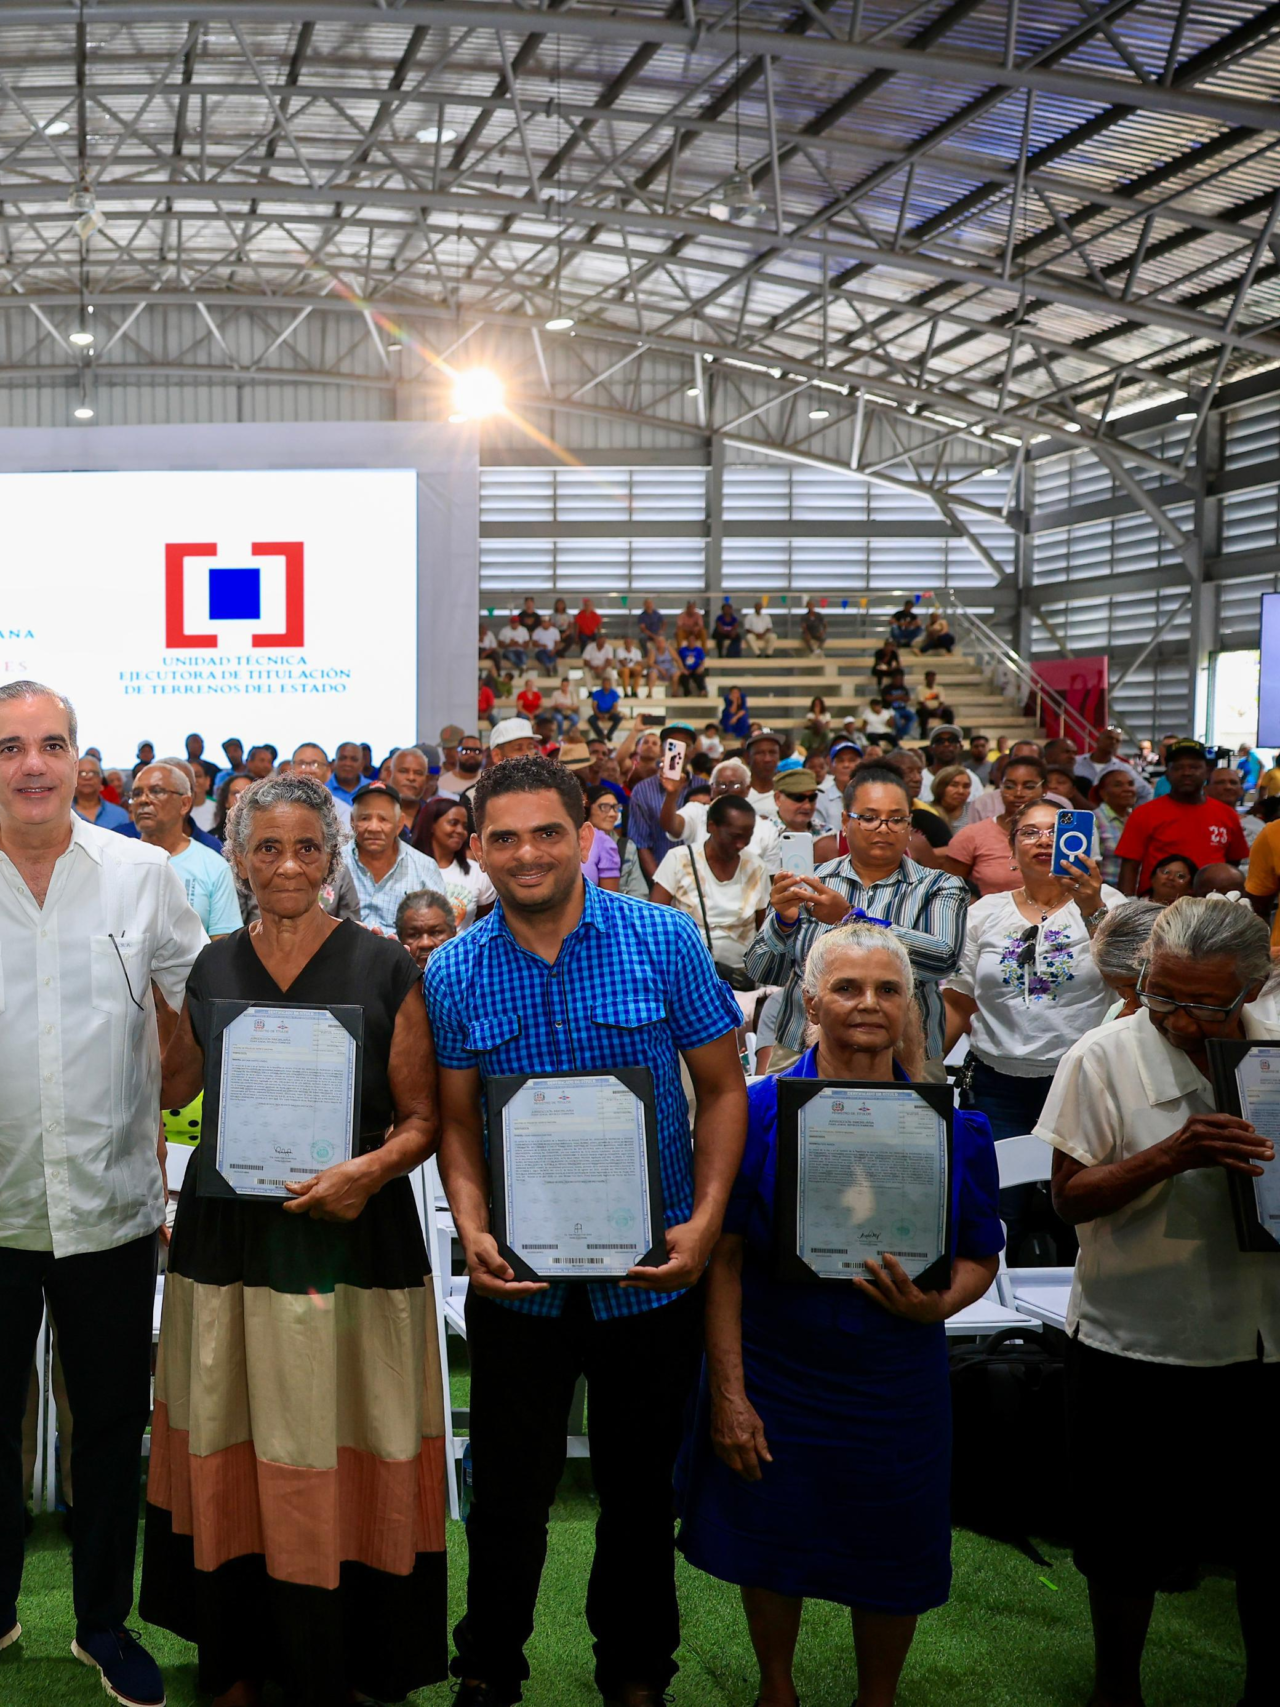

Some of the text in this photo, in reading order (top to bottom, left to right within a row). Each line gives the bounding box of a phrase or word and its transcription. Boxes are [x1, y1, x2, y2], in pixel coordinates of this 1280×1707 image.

[162, 654, 308, 667] UNIDAD TÉCNICA
[119, 667, 351, 682] EJECUTORA DE TITULACIÓN
[124, 682, 347, 695] DE TERRENOS DEL ESTADO
[1208, 826, 1228, 844] 23
